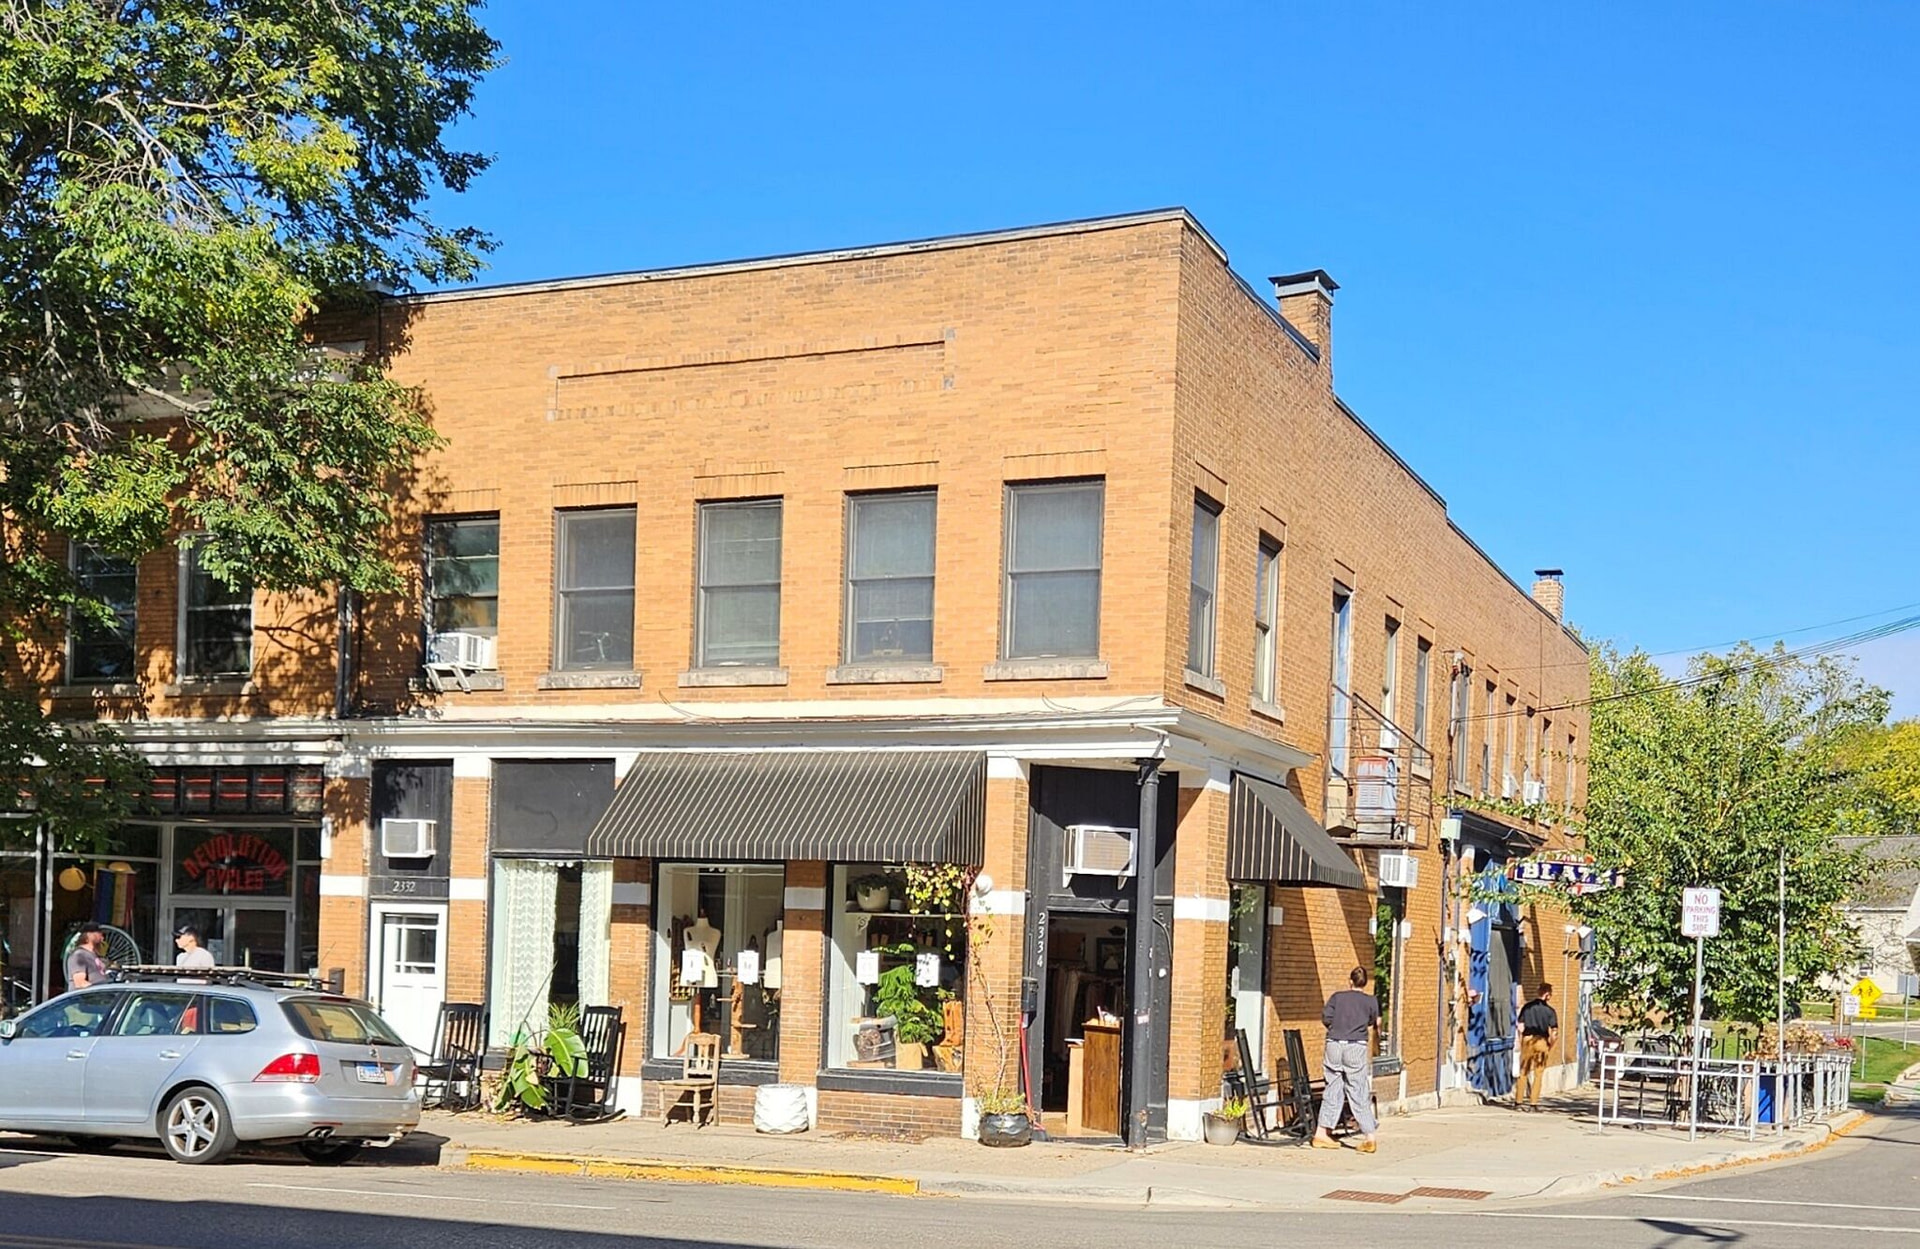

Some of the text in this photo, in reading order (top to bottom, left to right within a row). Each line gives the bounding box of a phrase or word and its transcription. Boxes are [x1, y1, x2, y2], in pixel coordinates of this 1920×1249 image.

[183, 833, 288, 879] REVOLUTION
[205, 869, 264, 891] CYCLES
[392, 880, 416, 892] 2332
[1694, 894, 1708, 905] NO
[1686, 905, 1716, 915] PARKING
[1692, 914, 1709, 923] THIS
[1692, 923, 1709, 932] SIDE
[1036, 912, 1046, 968] 2334
